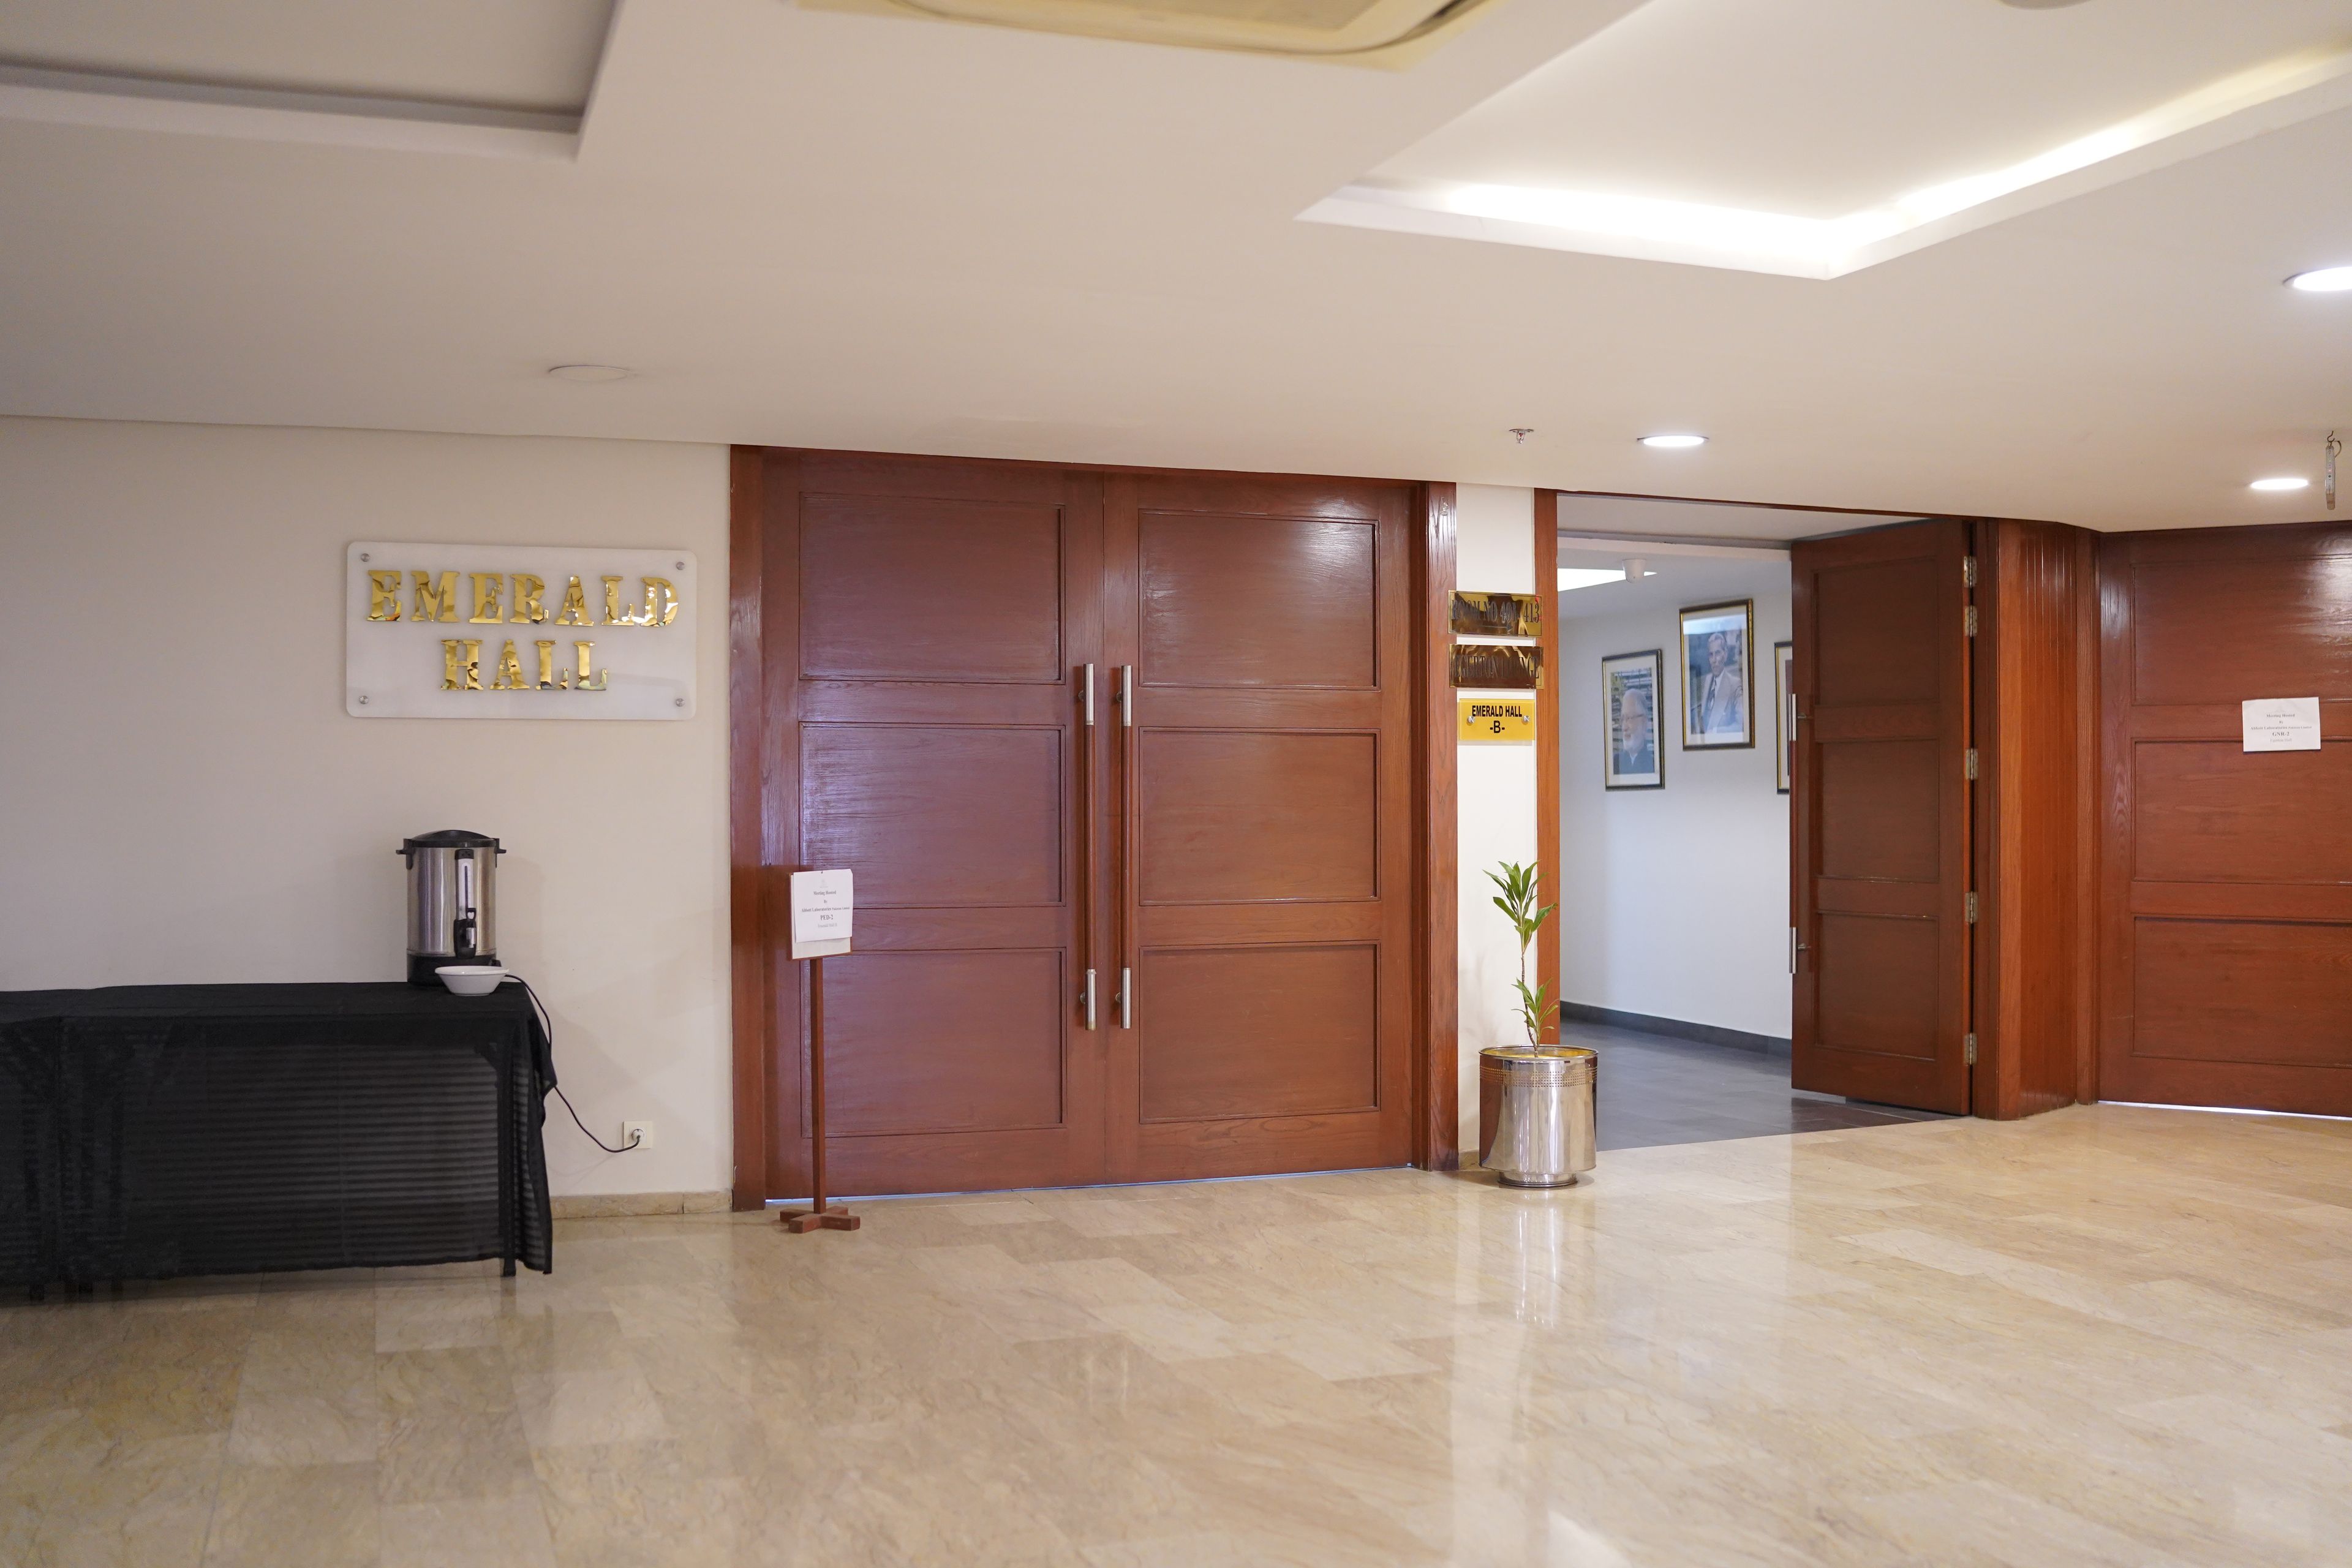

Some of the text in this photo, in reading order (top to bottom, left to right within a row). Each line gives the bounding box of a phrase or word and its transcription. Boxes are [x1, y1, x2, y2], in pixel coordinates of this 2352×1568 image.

[367, 570, 679, 627] EMERALD
[1483, 600, 1498, 622] NO
[440, 639, 607, 691] HALL
[1472, 705, 1522, 717] EMERALD HALL
[1490, 720, 1505, 733] -B-
